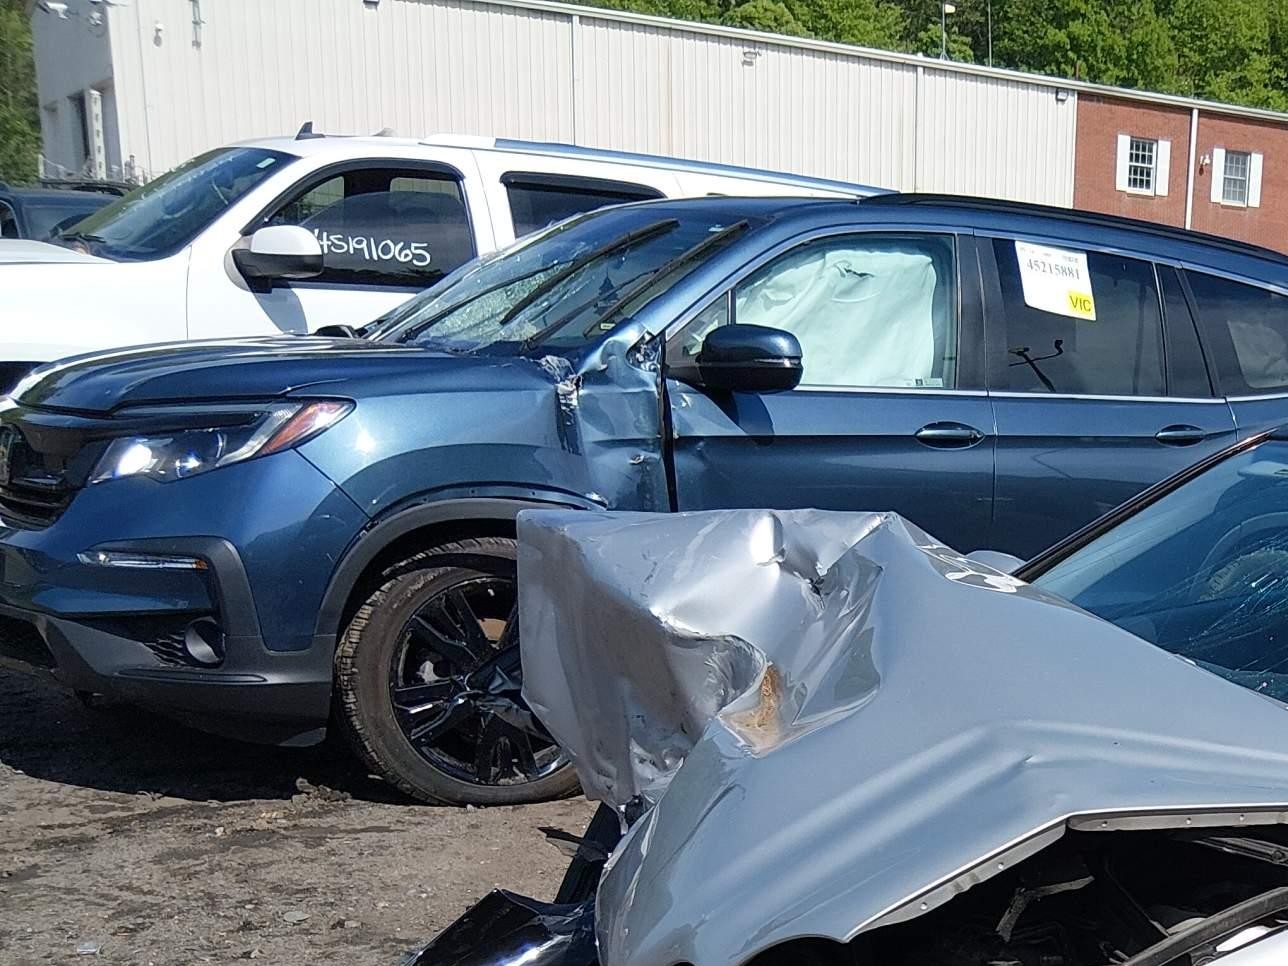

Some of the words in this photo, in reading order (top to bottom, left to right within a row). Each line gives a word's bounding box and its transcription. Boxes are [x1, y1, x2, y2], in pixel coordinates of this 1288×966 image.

[314, 228, 431, 267] 45191065
[1027, 258, 1080, 280] 45215881
[1069, 295, 1092, 312] VIC
